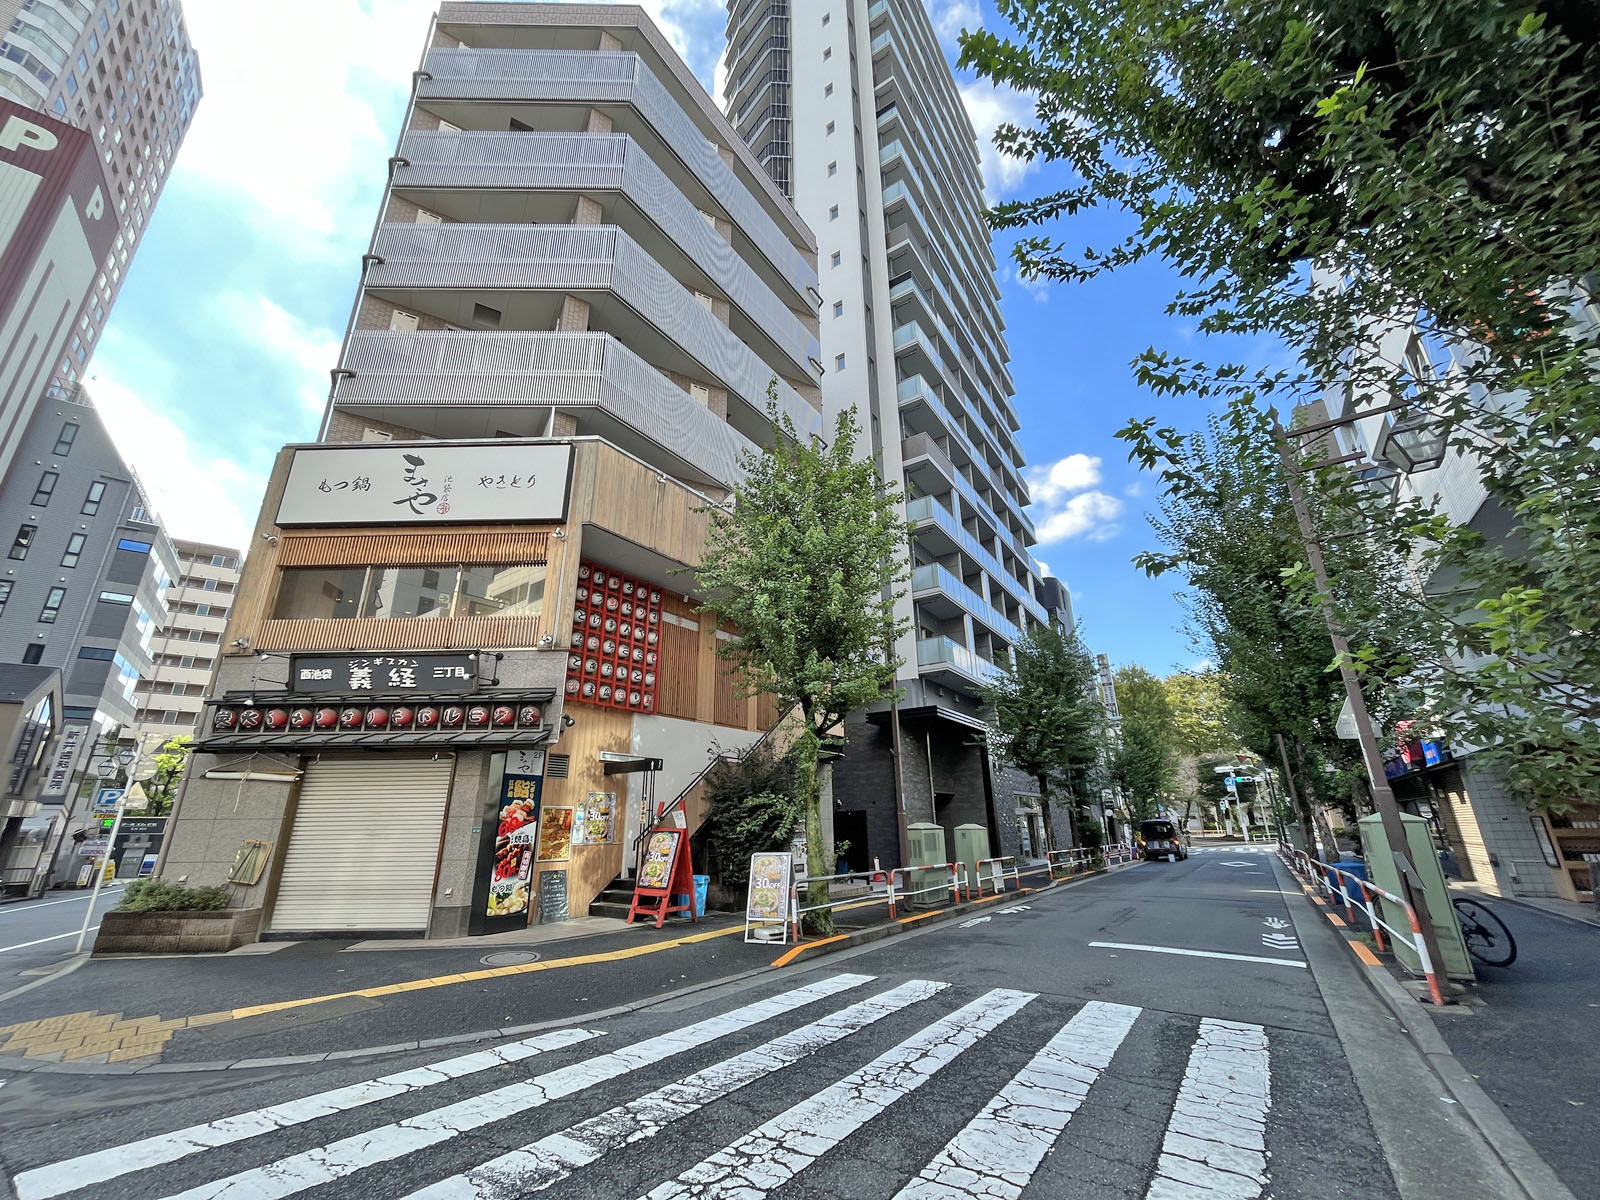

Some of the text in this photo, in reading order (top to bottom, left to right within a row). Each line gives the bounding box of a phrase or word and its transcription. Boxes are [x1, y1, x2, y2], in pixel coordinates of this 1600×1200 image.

[0, 115, 58, 151] P
[318, 476, 371, 493] もつ鍋
[478, 473, 538, 489] やきとり
[348, 657, 419, 668] ジンギスカン
[300, 668, 333, 680] 西池袋
[349, 667, 418, 690] 義経
[432, 666, 466, 678] 三丁目
[533, 751, 543, 759] 2F
[100, 791, 121, 804] P
